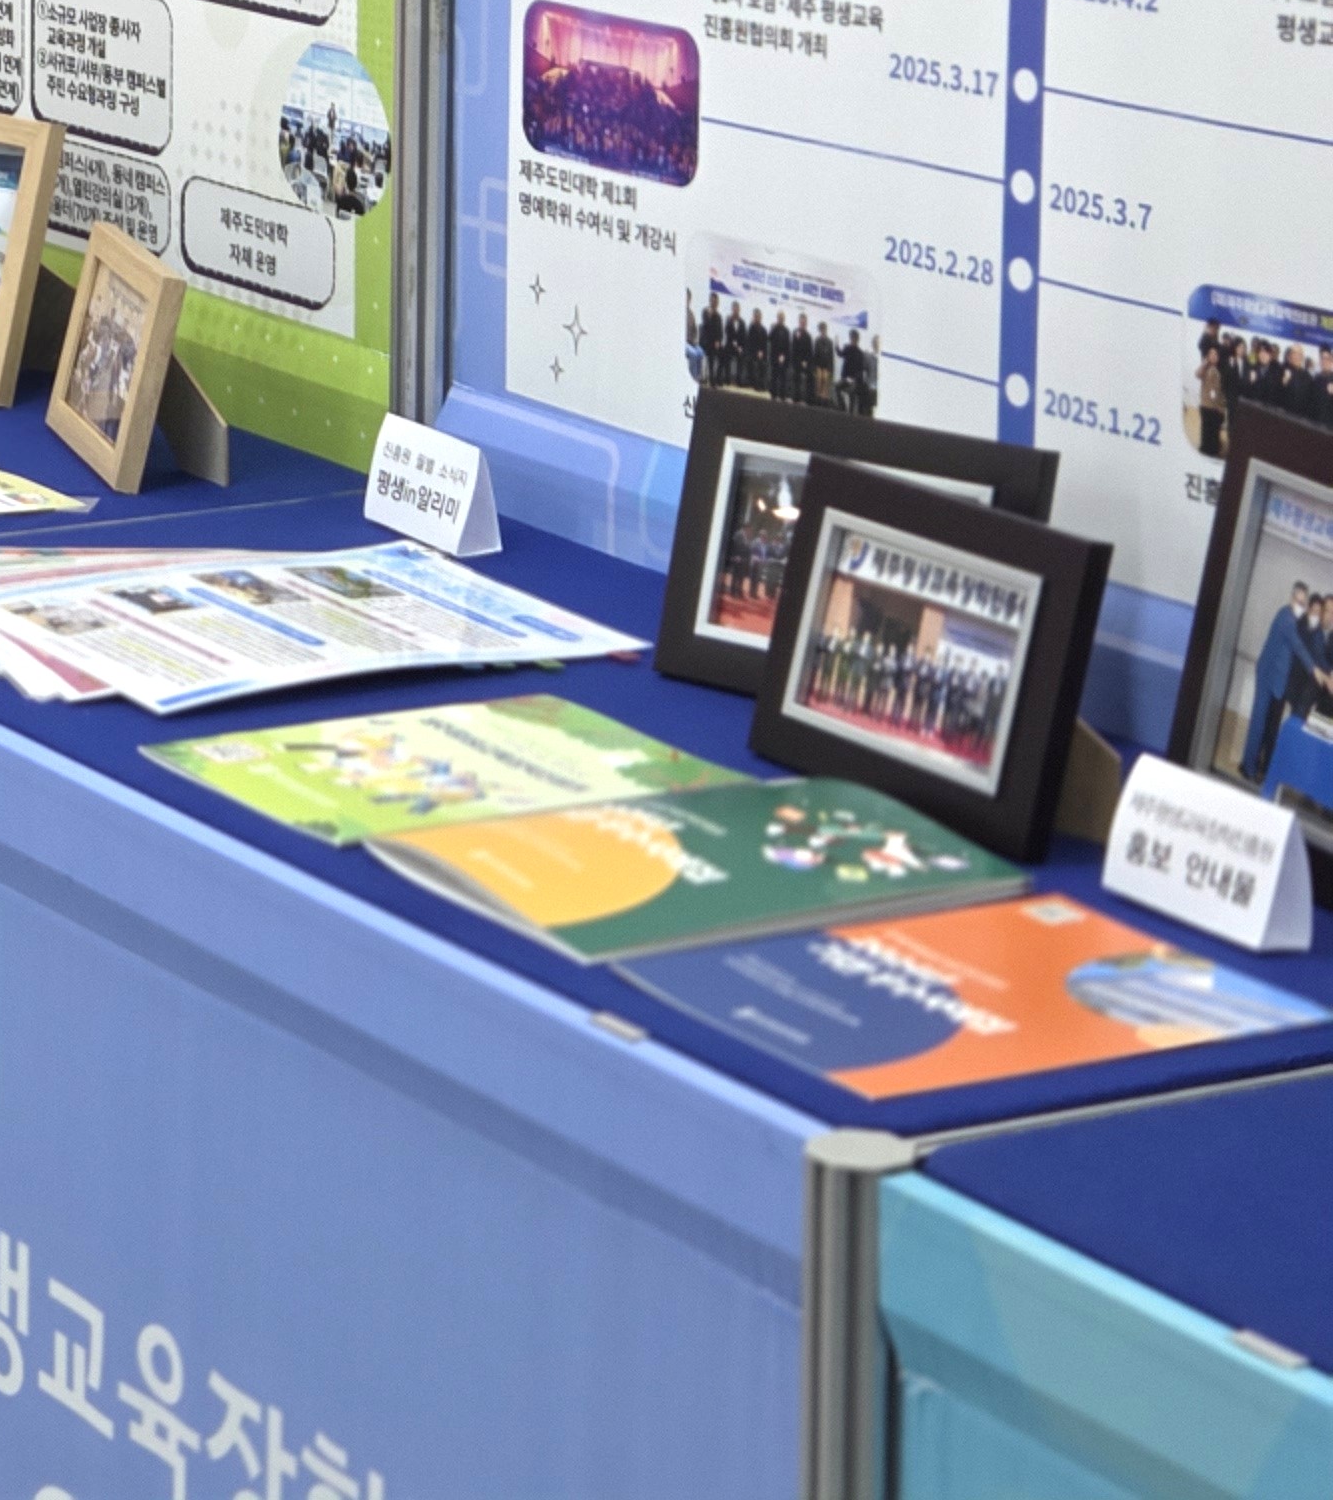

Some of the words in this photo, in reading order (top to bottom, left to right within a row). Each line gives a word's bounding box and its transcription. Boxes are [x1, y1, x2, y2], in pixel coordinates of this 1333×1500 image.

[888, 52, 1000, 98] 2025.3.17
[1049, 183, 1153, 232] 2025.3.7
[884, 235, 994, 287] 2025.2.28
[1043, 388, 1162, 447] 2025.1.22
